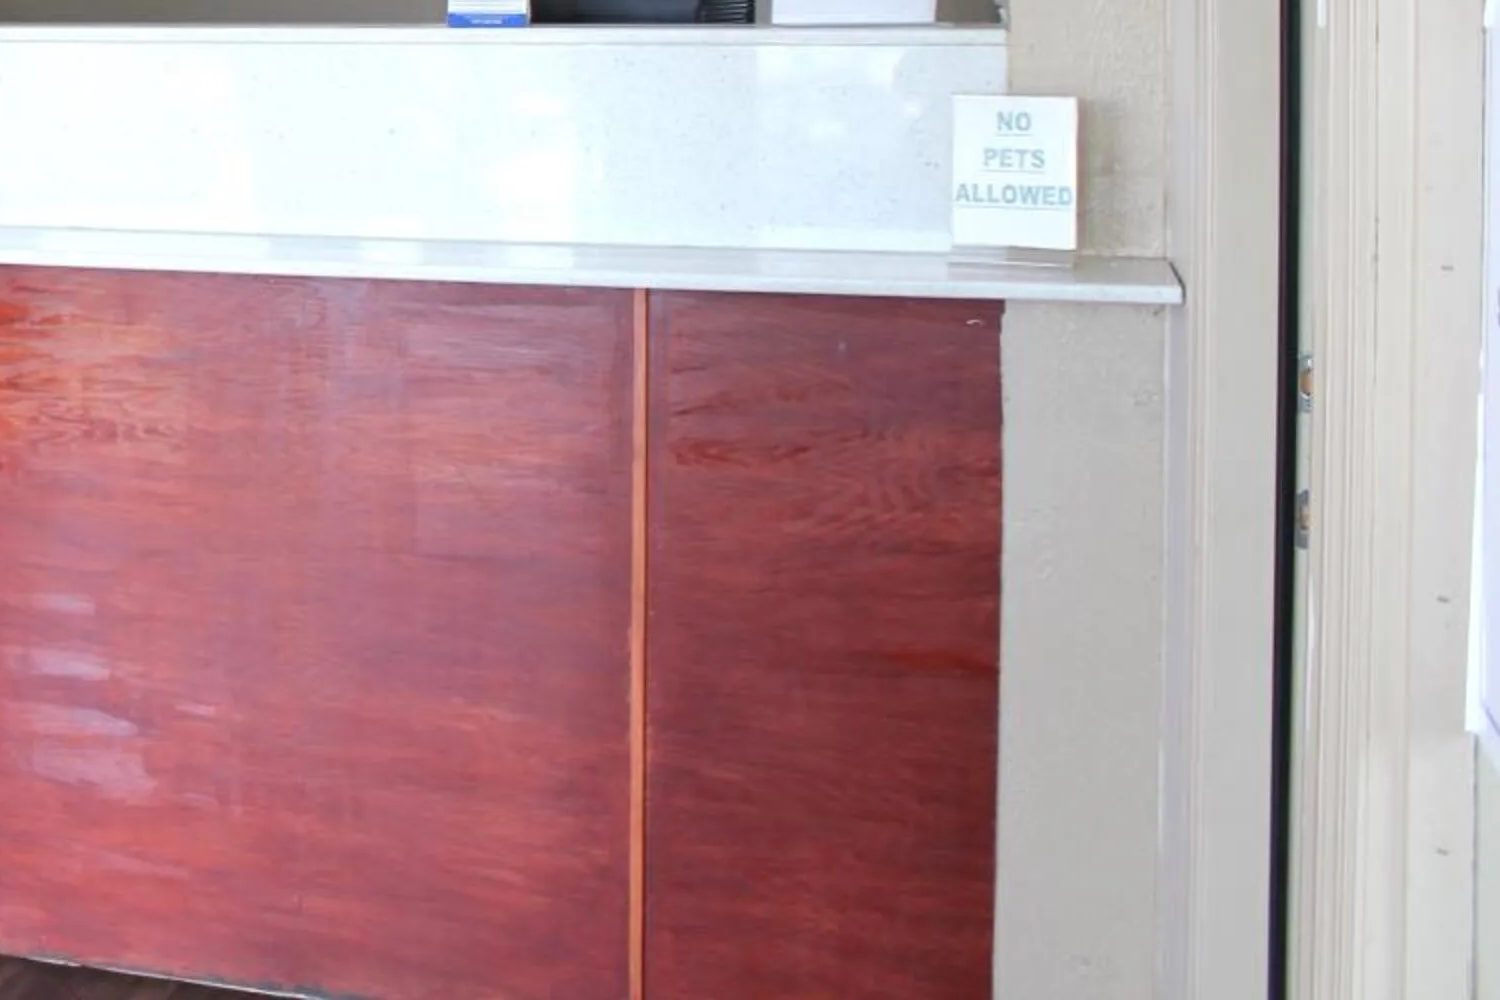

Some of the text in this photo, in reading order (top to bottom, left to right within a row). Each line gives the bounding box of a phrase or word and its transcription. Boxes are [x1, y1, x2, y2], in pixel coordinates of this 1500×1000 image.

[996, 111, 1033, 132] NO
[983, 147, 1046, 169] PETS
[954, 181, 1074, 207] ALLOWED
